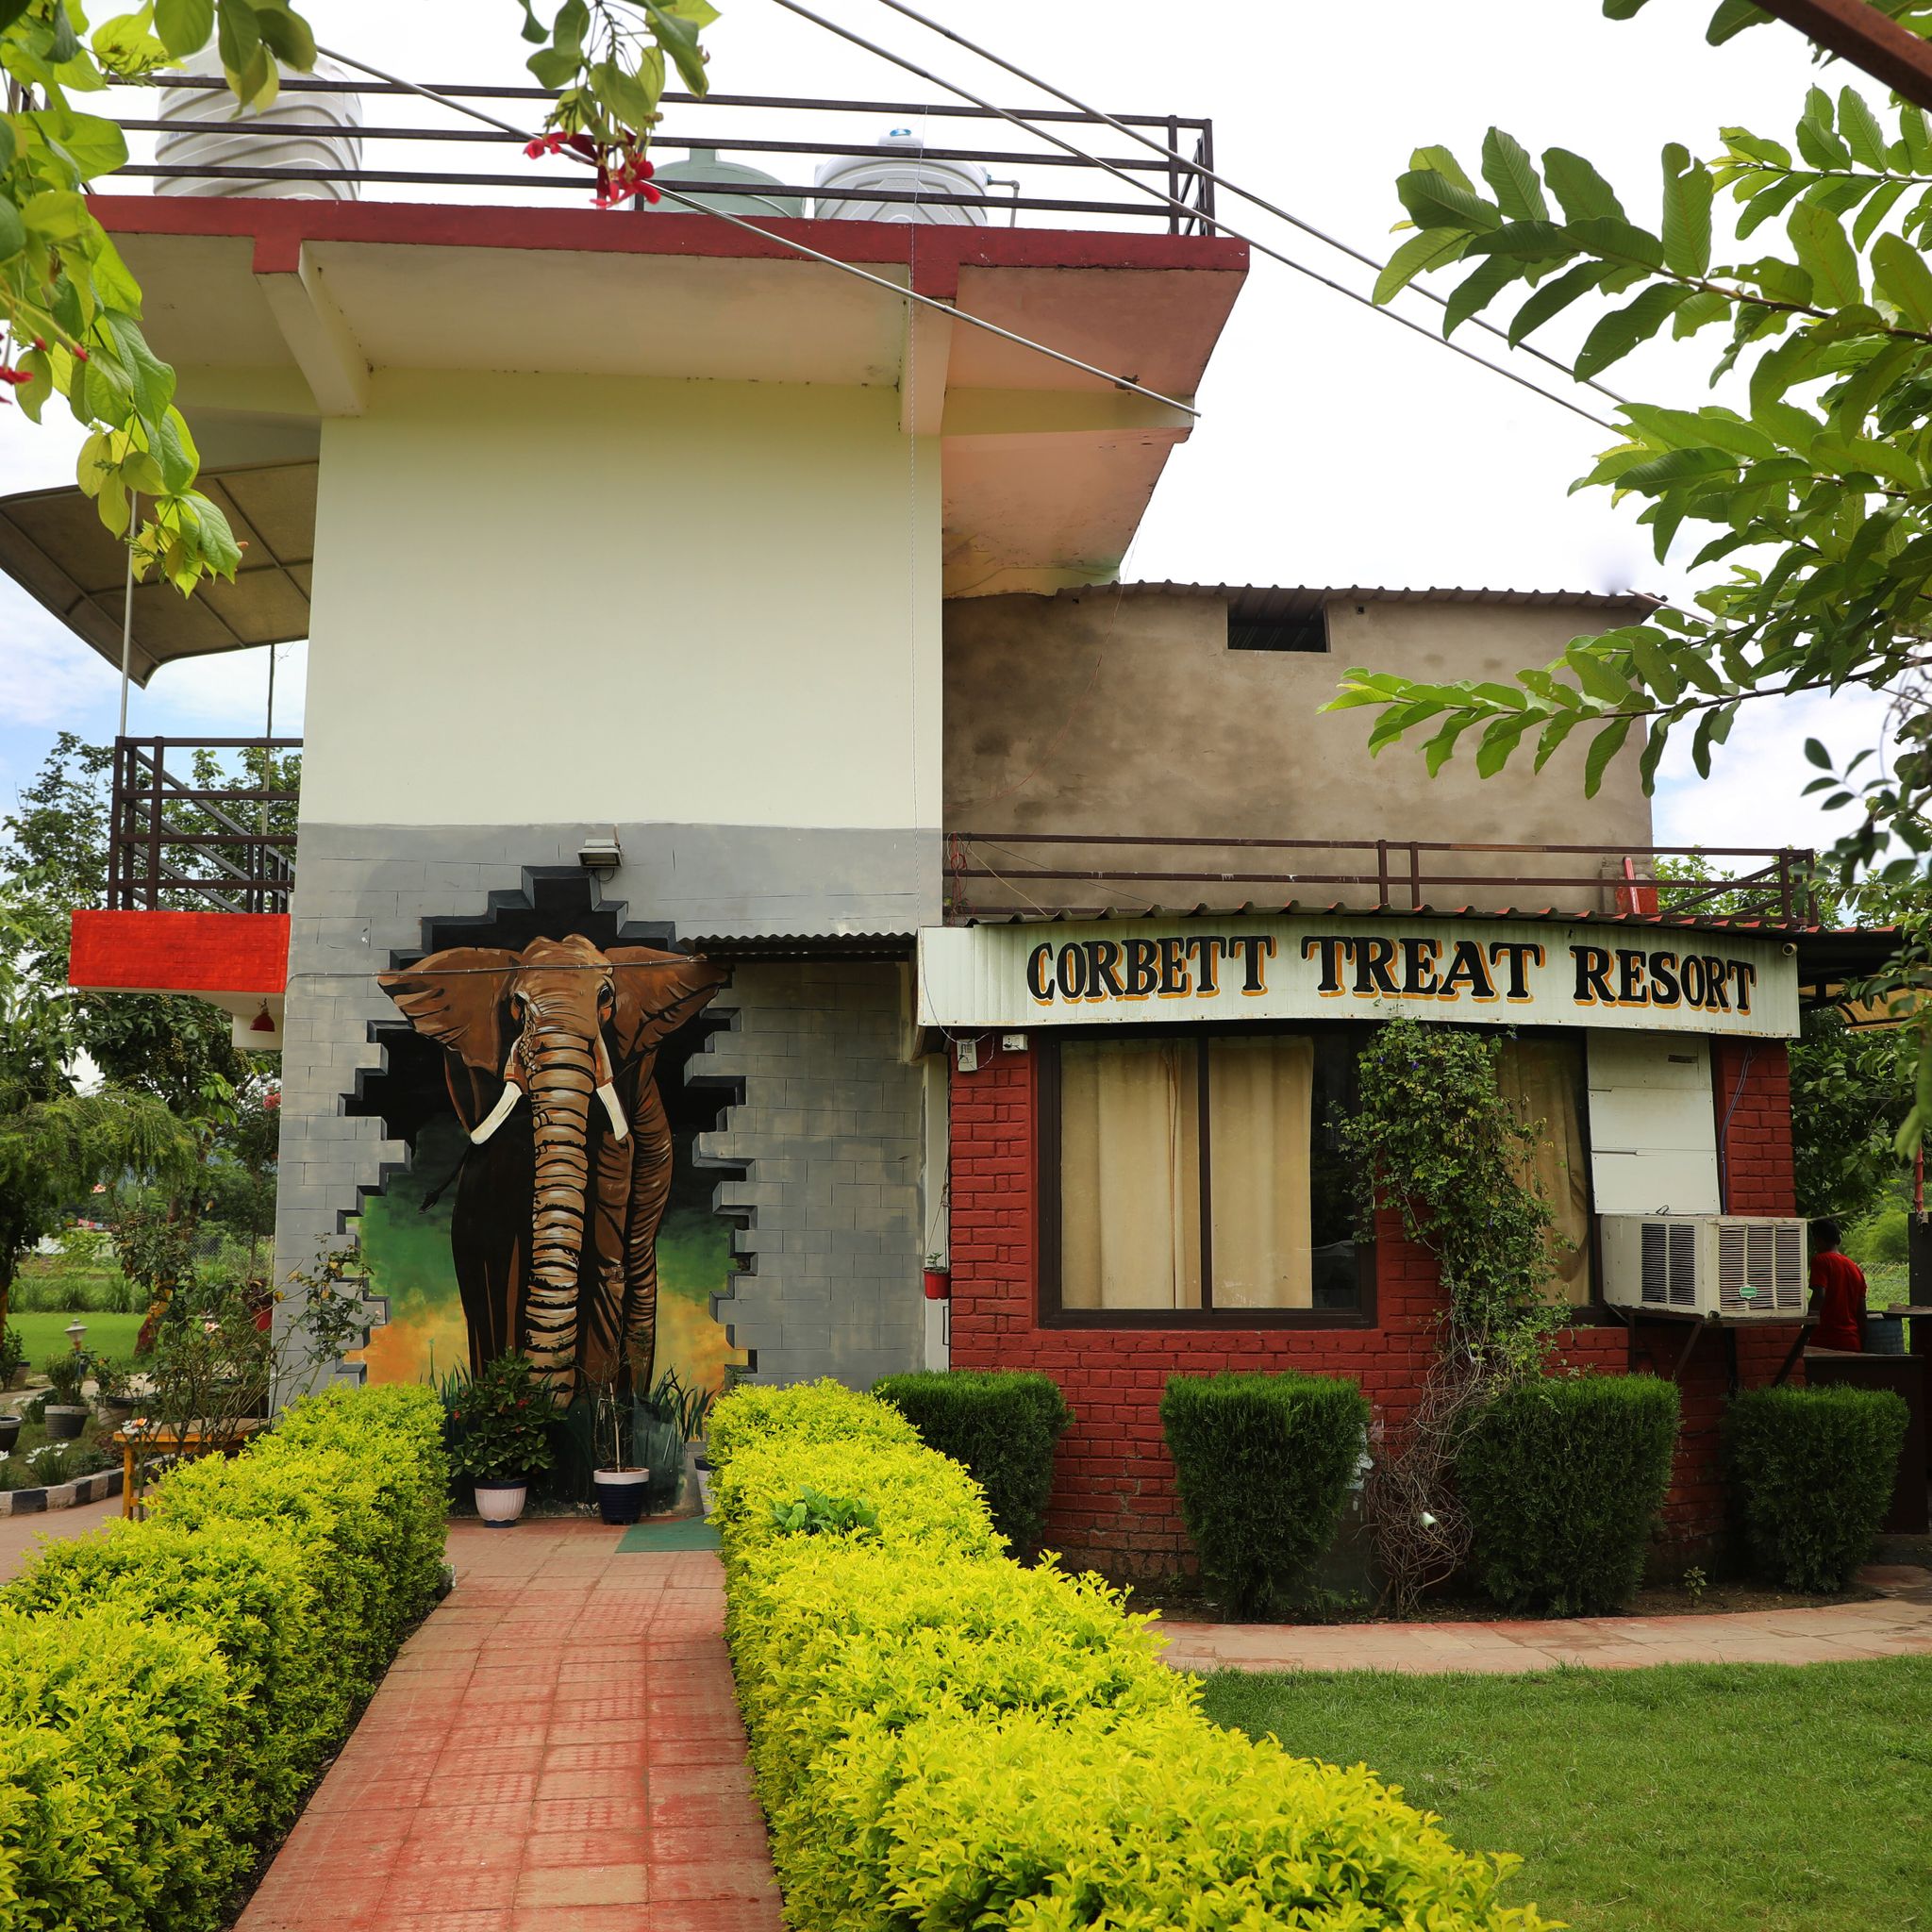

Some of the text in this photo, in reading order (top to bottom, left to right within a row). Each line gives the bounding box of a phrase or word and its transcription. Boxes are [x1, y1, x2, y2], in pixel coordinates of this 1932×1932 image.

[1026, 935, 1757, 1016] CORBETT TREAT RESORT
